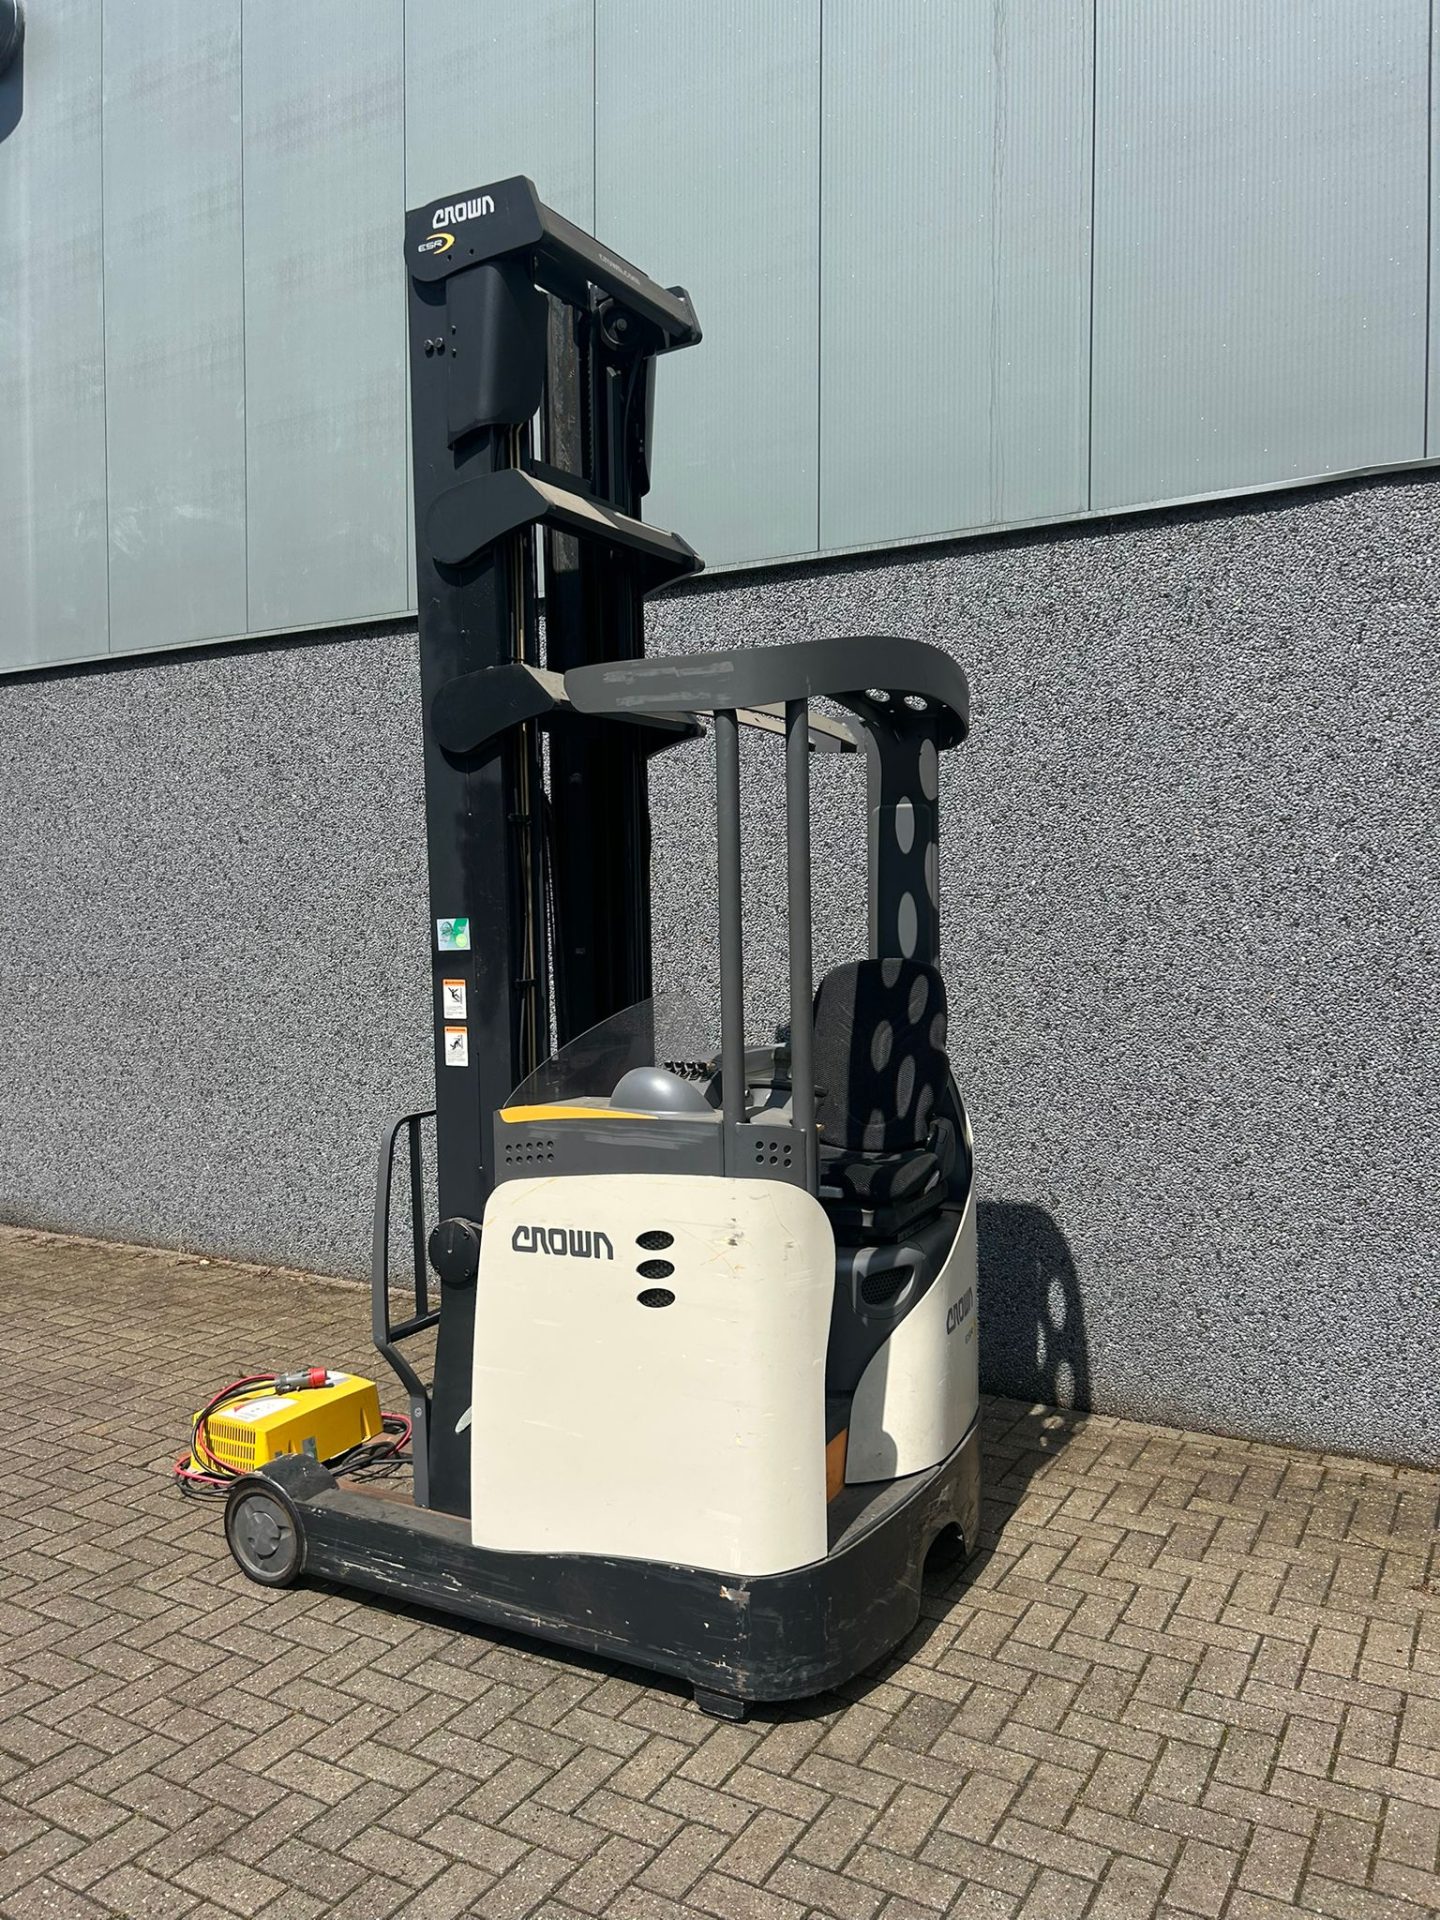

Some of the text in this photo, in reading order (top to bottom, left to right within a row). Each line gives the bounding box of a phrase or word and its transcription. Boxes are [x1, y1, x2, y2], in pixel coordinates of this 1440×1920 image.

[432, 195, 495, 229] CROWN
[418, 240, 443, 252] ESR
[511, 1225, 614, 1260] CROWN
[946, 1286, 973, 1335] CROWN
